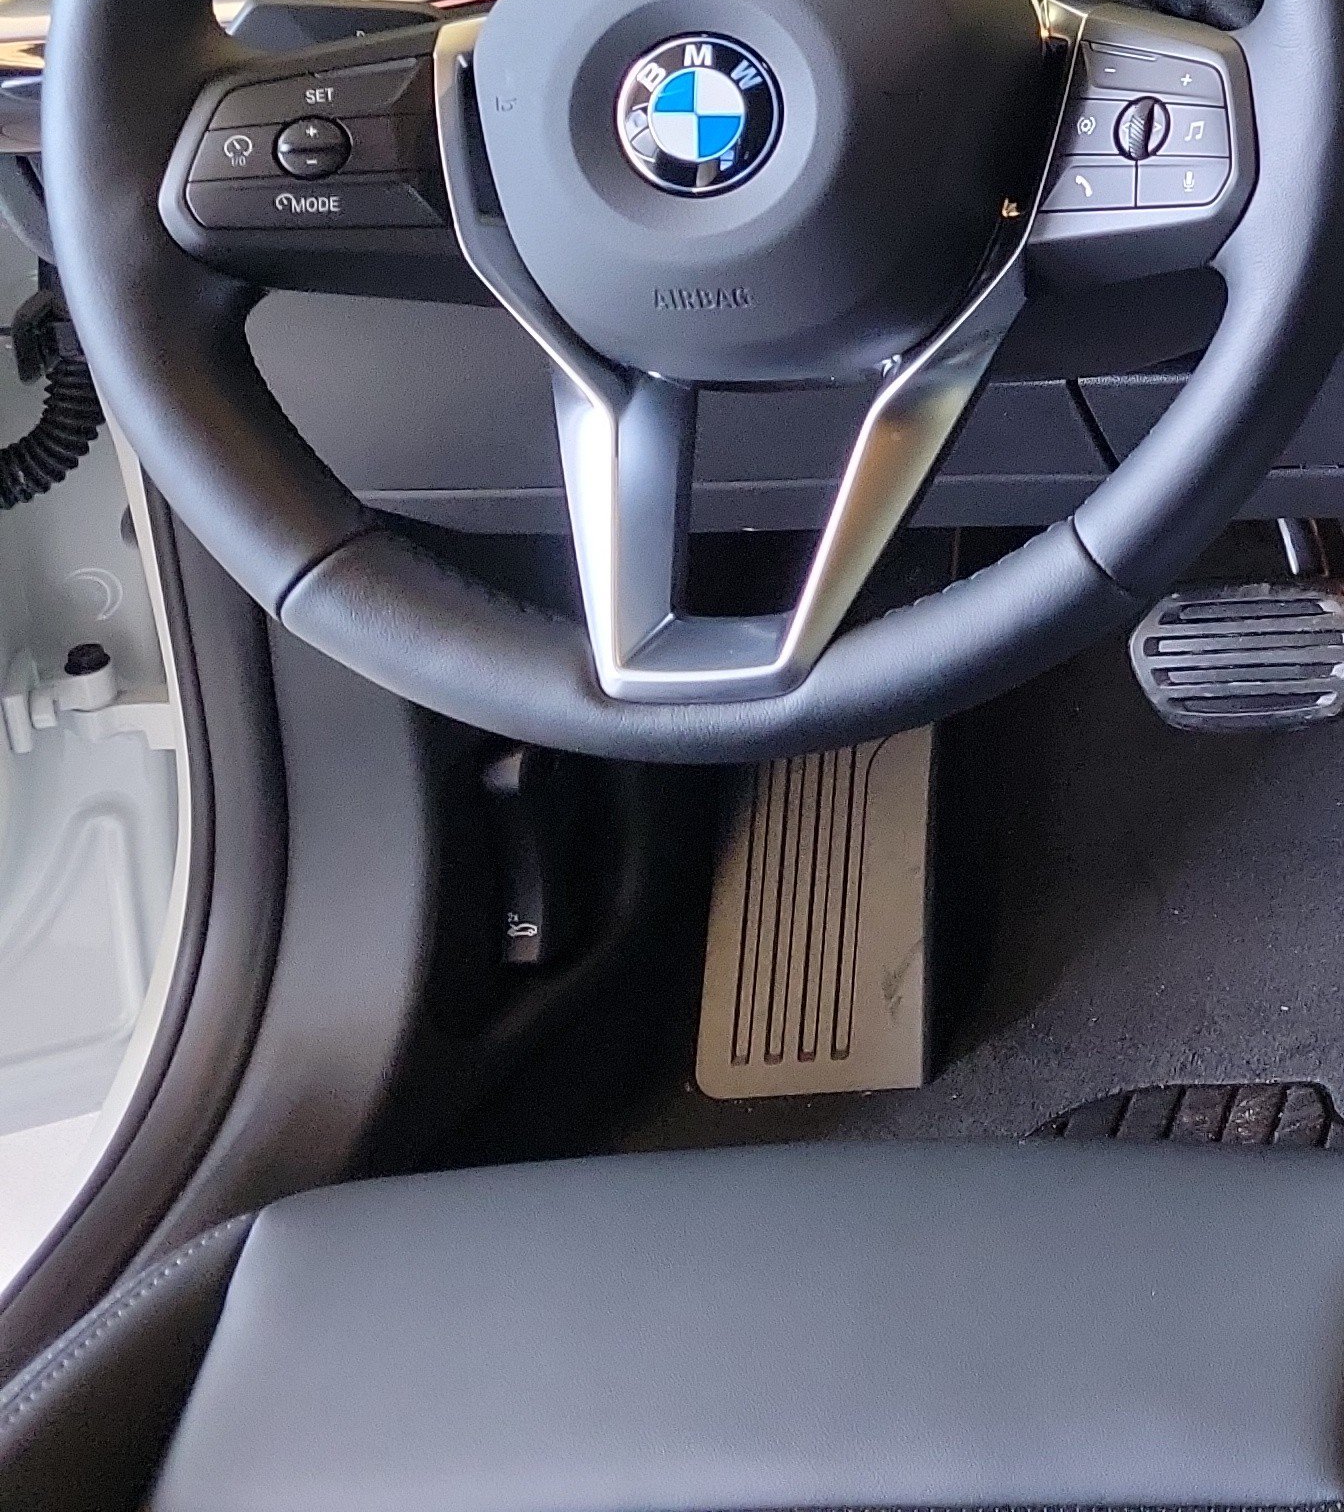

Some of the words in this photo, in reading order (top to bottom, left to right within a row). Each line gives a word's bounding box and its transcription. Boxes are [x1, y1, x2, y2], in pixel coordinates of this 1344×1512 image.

[637, 44, 764, 93] BMW
[305, 87, 334, 105] SET
[291, 196, 341, 213] MODE
[653, 288, 751, 311] AIRBAG
